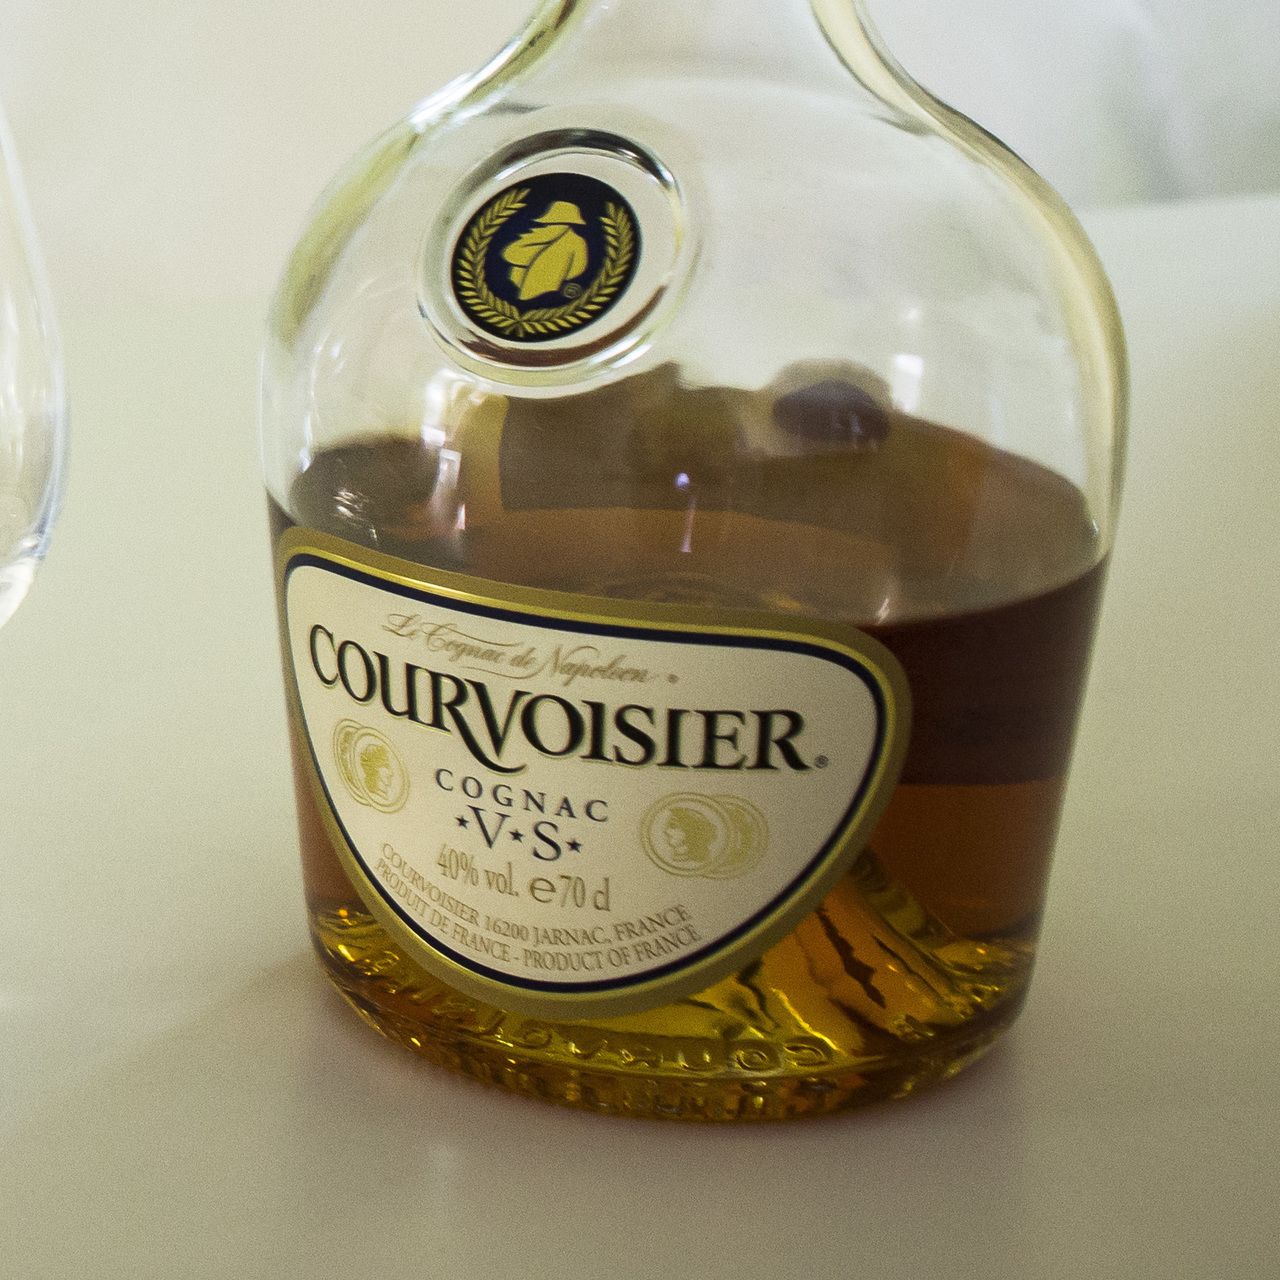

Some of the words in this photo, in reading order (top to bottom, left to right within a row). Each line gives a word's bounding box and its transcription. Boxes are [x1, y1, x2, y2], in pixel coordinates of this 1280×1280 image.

[420, 622, 524, 662] Cognac
[509, 646, 537, 669] de
[435, 768, 609, 823] COGNAC
[382, 843, 480, 927] COURVOISIER
[485, 916, 530, 942] 16200
[613, 904, 690, 942] FRANCE
[437, 843, 480, 887] 40%
[485, 862, 519, 897] vol.
[374, 858, 430, 918] PRODUIT
[429, 909, 451, 935] DE
[452, 923, 511, 963] FRANCE
[524, 947, 604, 971] PRODUCT
[608, 946, 631, 969] OF
[633, 923, 702, 964] FRANCE
